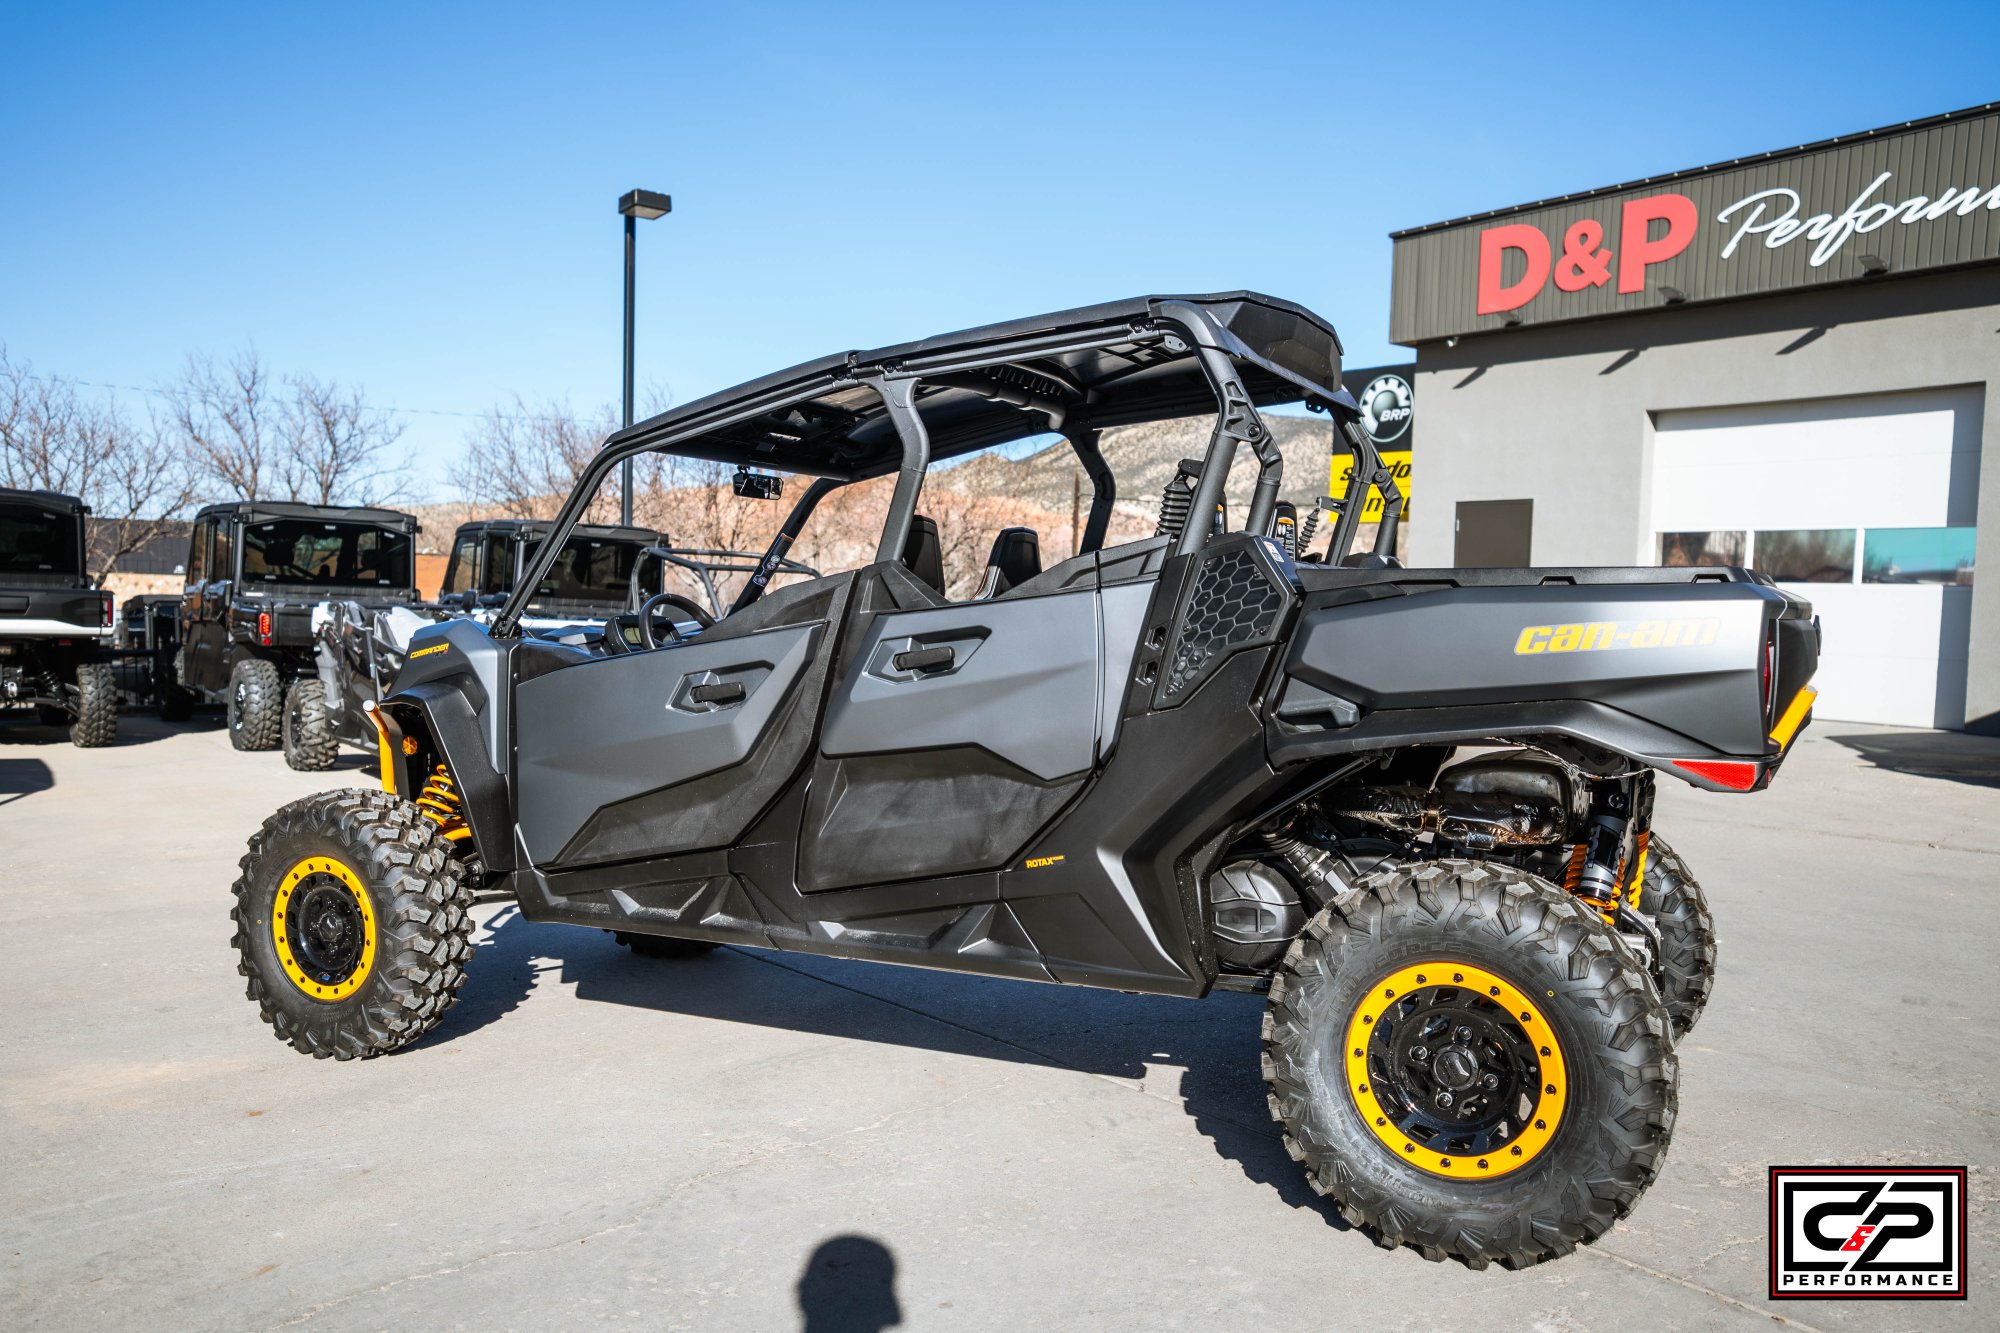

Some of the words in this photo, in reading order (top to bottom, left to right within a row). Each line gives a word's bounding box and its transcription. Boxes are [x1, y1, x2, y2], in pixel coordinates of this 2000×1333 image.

[1477, 193, 1699, 316] D&P
[1380, 408, 1411, 422] BRP
[1515, 618, 1721, 655] can-am
[1026, 857, 1053, 868] ROTAX
